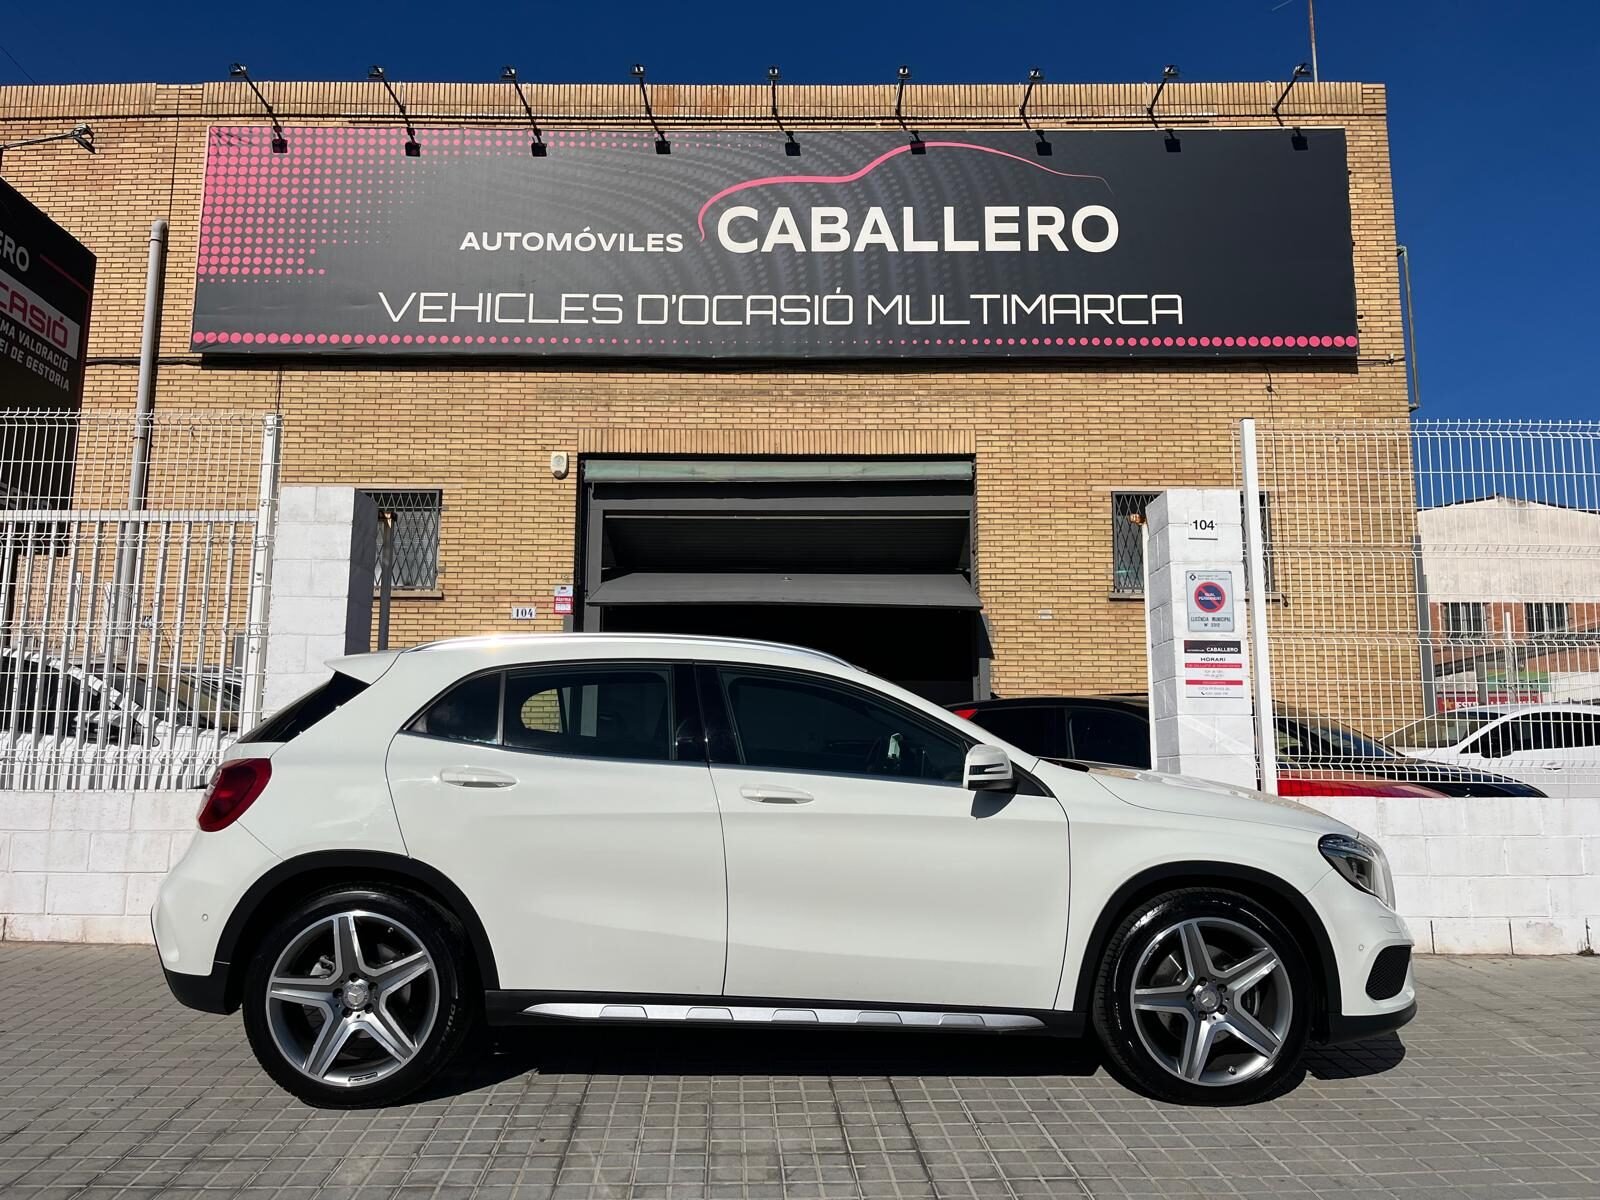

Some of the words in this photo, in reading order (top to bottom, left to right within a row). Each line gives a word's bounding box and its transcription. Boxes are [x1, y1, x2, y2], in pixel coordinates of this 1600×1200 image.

[0, 229, 30, 272] RO
[459, 226, 684, 252] AUTOMÓVILES
[717, 205, 1120, 254] CABALLERO
[378, 291, 624, 325] VEHICLES
[636, 287, 855, 326] D'OCASIÓ
[10, 346, 25, 364] DE
[25, 354, 71, 392] GESTORIA
[18, 329, 70, 372] VALORACIÓ
[1192, 519, 1215, 531] 104
[515, 608, 533, 618] 104
